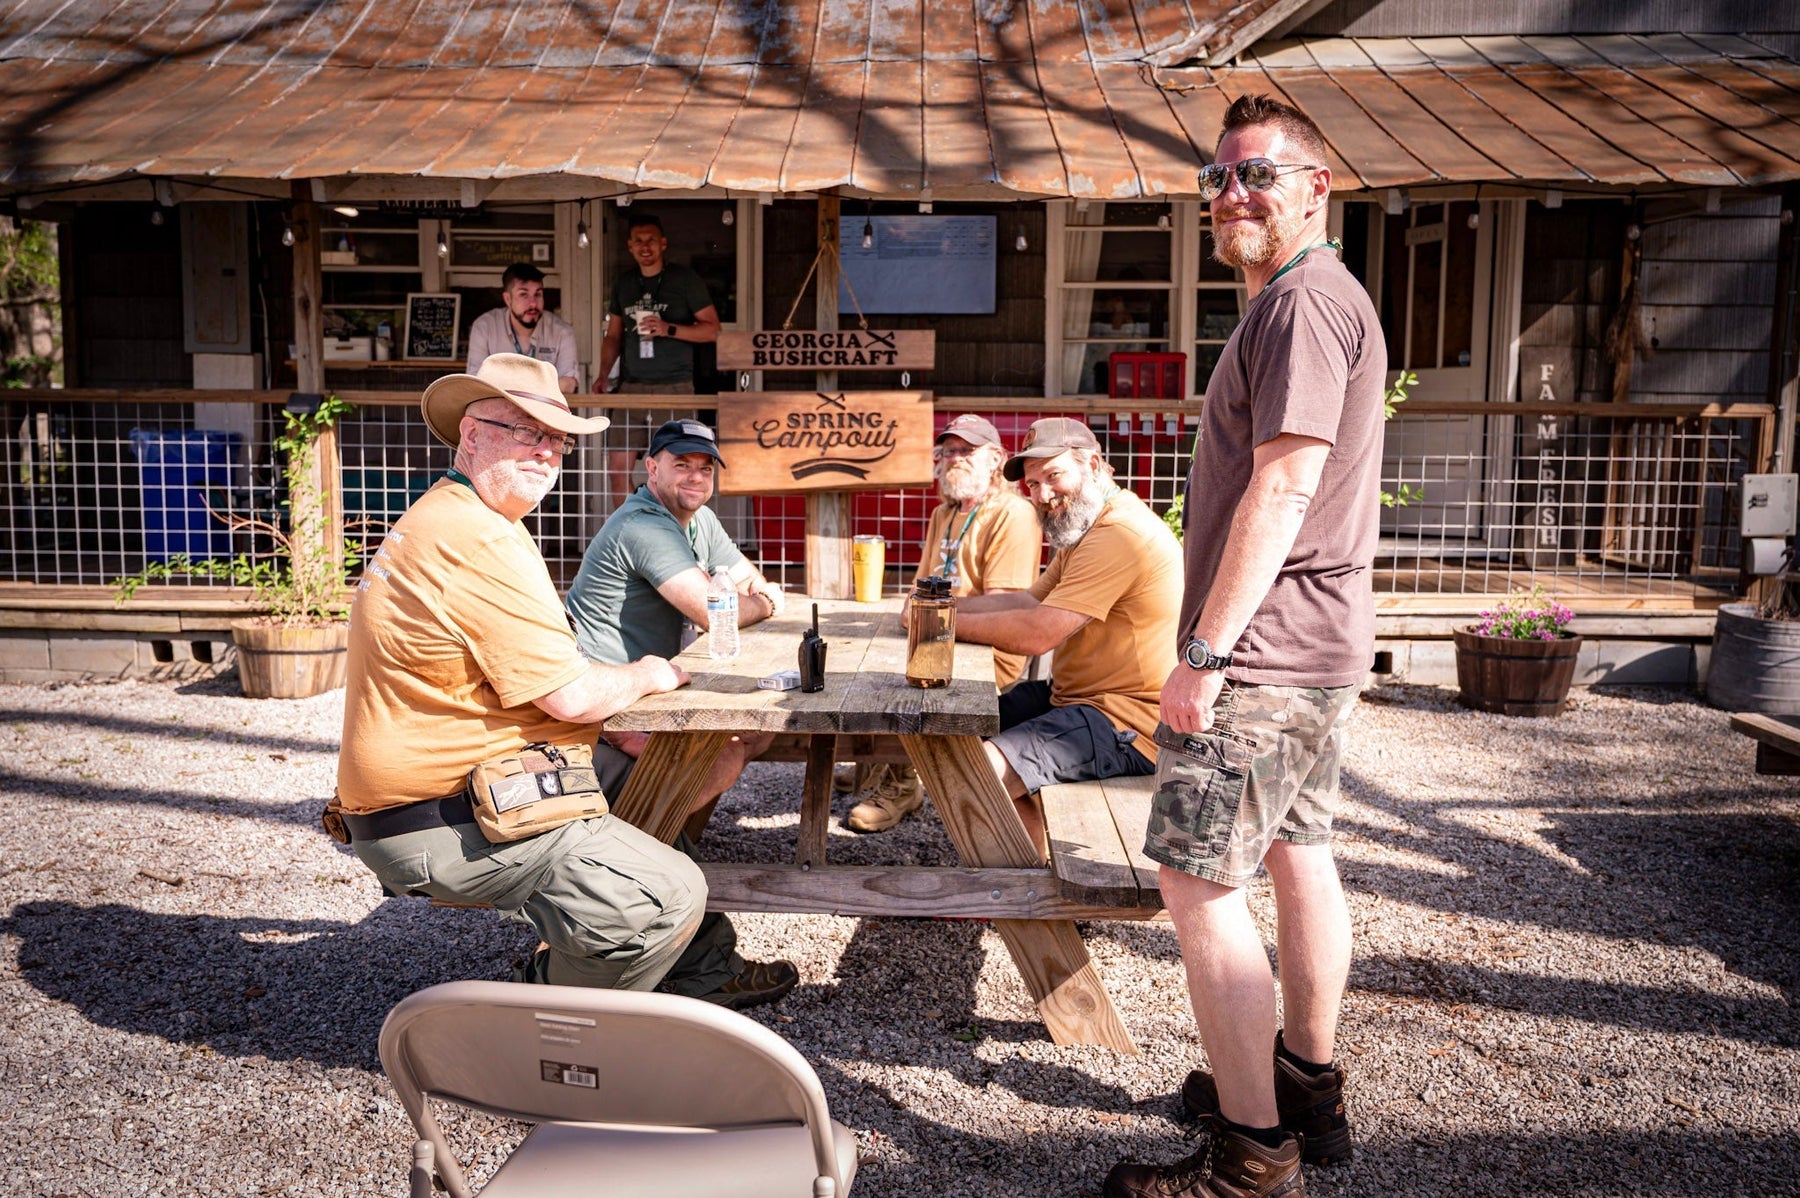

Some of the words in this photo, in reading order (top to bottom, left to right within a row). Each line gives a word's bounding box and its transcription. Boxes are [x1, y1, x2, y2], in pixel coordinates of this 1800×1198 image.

[752, 333, 861, 349] GEORGIA
[753, 350, 898, 366] BUSHCRAFT
[786, 412, 883, 429] SPRING
[752, 419, 898, 457] Campout
